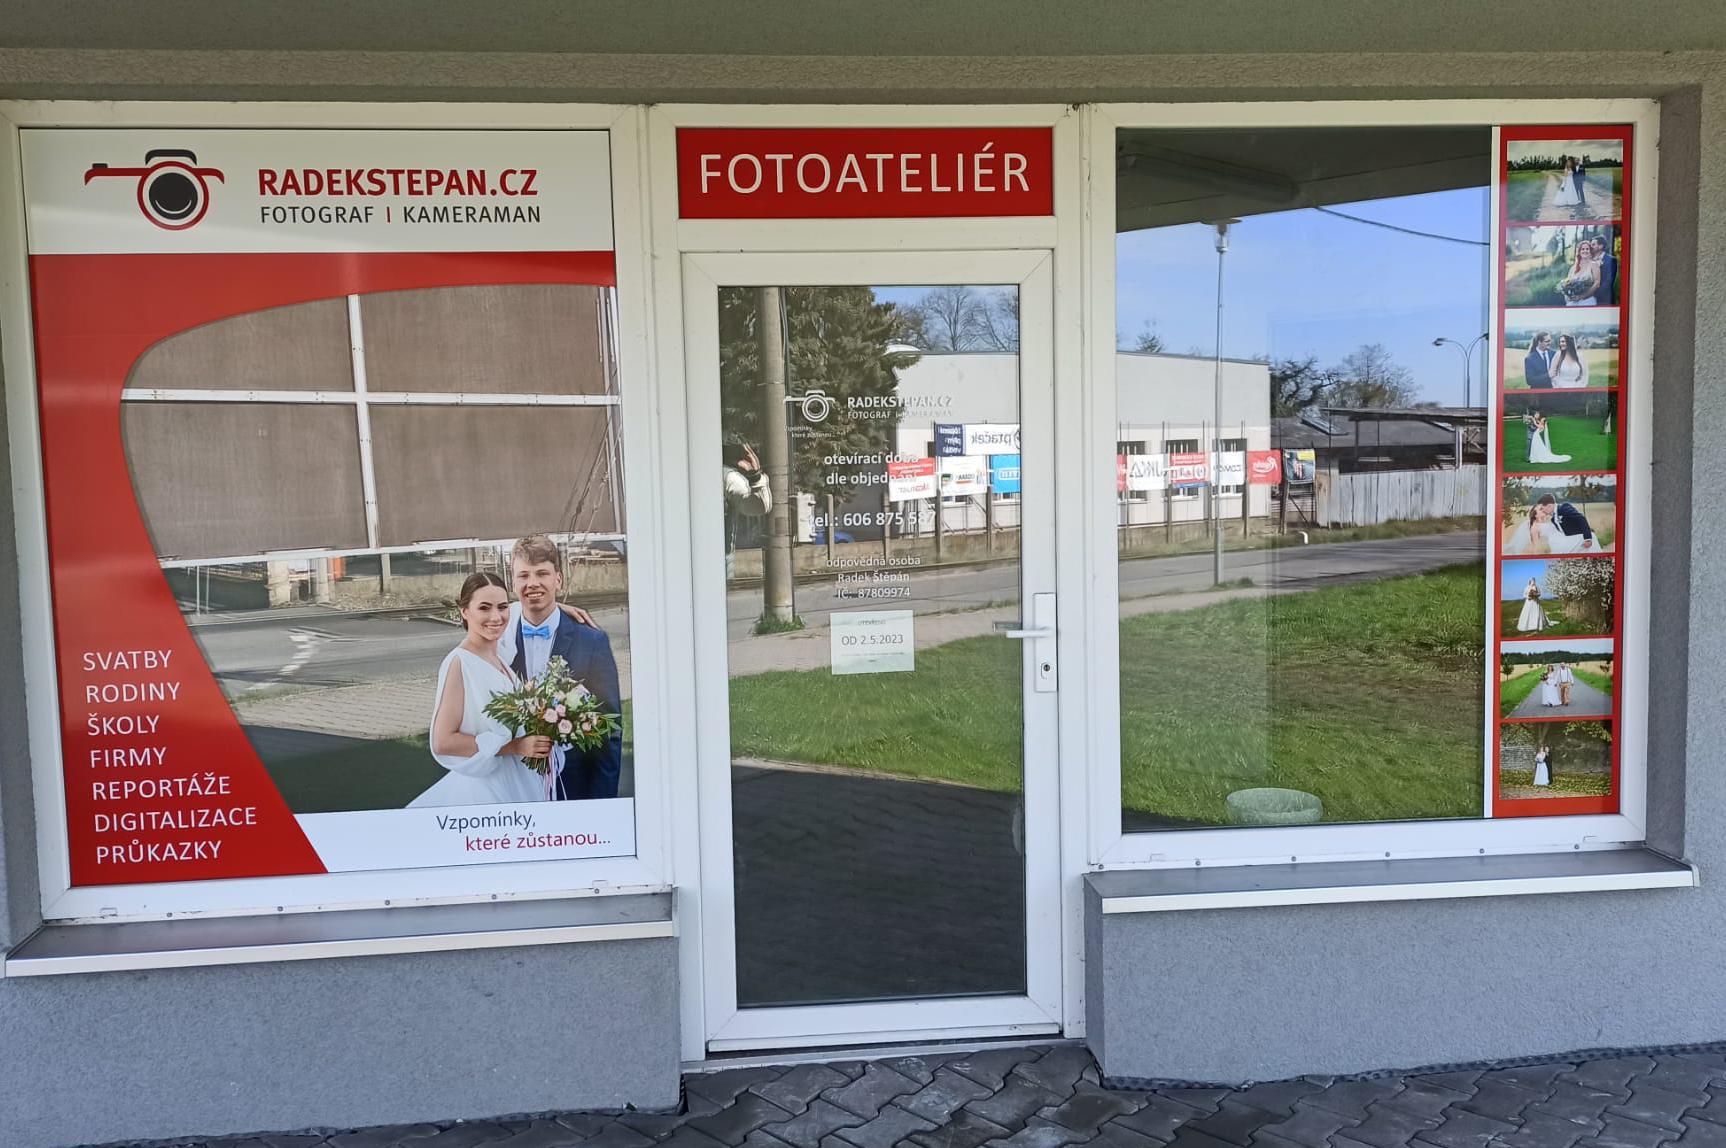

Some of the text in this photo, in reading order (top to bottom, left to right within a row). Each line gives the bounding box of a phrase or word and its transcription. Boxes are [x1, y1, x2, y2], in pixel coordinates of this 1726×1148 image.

[700, 142, 1030, 194] FOTOATELIÉR
[258, 168, 538, 197] RADEKSTEPAN.CZ
[260, 205, 374, 224] FOTOGRAF
[403, 205, 541, 224] KAMERAMAN
[847, 410, 891, 419] FOTOGRAF
[824, 452, 882, 465] otevírací
[826, 472, 847, 485] dle
[843, 513, 872, 527] 606
[876, 512, 904, 526] 875
[908, 511, 936, 526] 587
[826, 555, 921, 569] odpovědná osoba
[838, 570, 910, 583] Radek Štěpán
[858, 587, 911, 598] 87809974
[841, 635, 857, 645] OD
[83, 650, 172, 671] SVATBY
[86, 682, 181, 704] RODINY
[87, 712, 160, 736] ŠKOLY
[90, 747, 167, 768] FIRMY
[92, 772, 231, 801] REPORTÁŽE
[94, 806, 257, 832] DIGITALIZACE
[436, 811, 536, 833] Vzpomínky,
[96, 839, 222, 864] PRŮKAZKY
[466, 832, 611, 851] které zůstanou...
